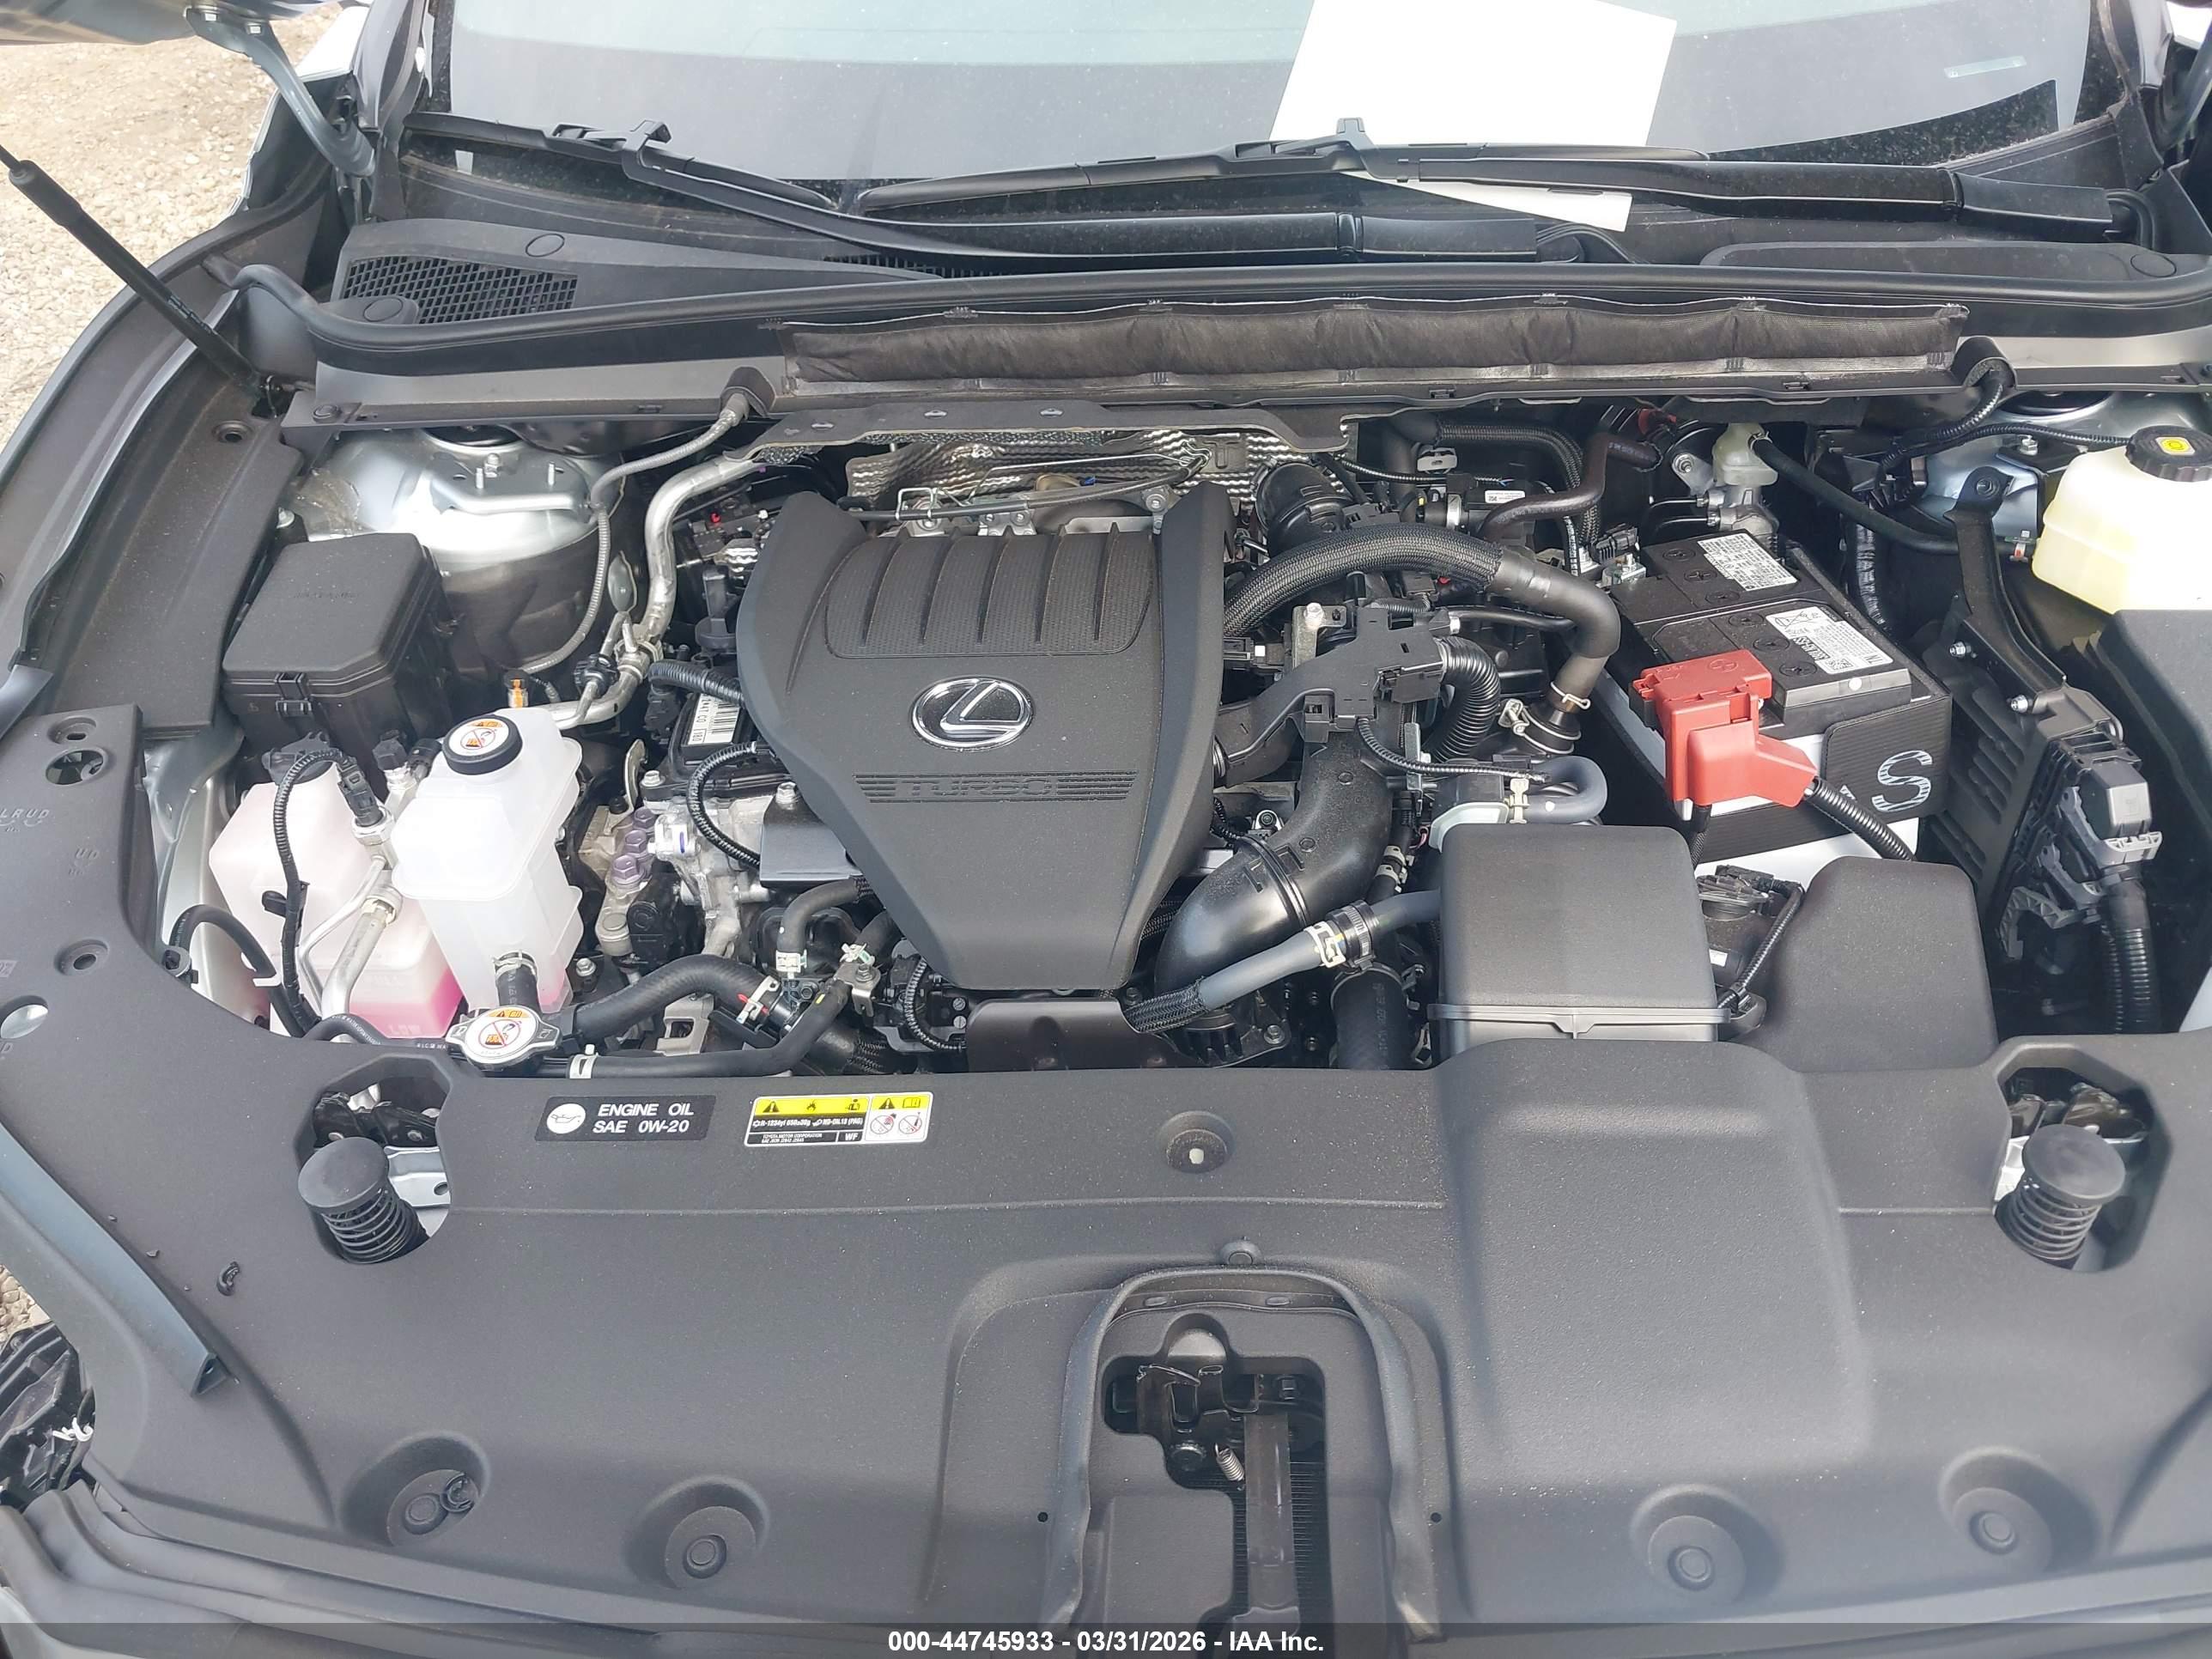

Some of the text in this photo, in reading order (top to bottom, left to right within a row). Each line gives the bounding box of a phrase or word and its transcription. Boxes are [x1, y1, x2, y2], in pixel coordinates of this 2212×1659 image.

[901, 778, 1053, 797] TURBO
[1871, 750, 1933, 812] S
[598, 1103, 695, 1116] ENGINE OIL
[592, 1120, 690, 1133] SAE 0W-20
